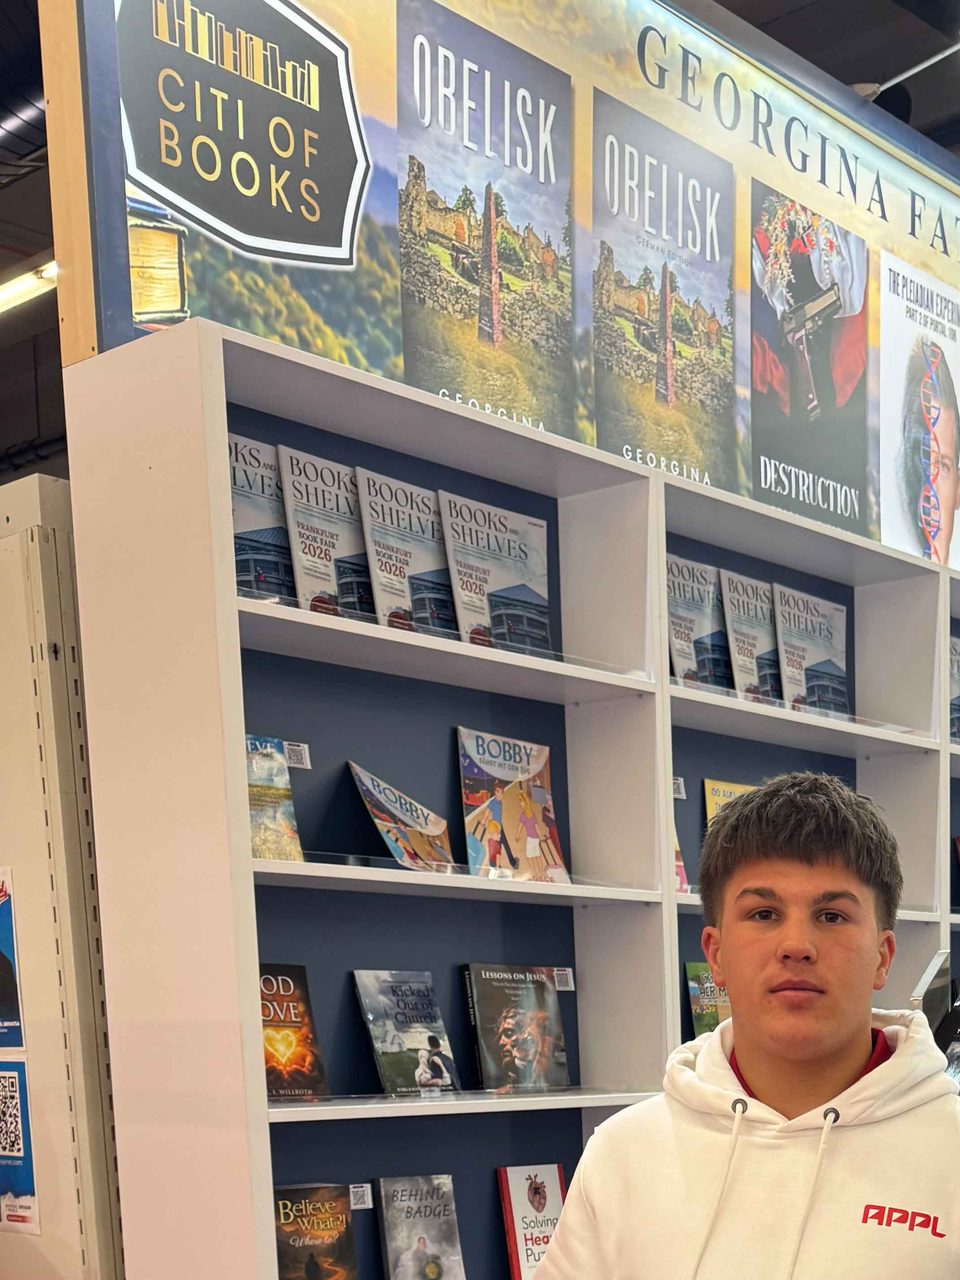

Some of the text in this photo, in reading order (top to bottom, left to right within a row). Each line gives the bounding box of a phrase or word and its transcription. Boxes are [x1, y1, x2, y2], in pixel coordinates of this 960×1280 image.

[157, 68, 320, 168] CITI OF
[412, 33, 559, 186] OBELISK
[637, 25, 889, 222] GEORGINA
[159, 118, 321, 222] BOOKS
[604, 134, 721, 262] OBELISK
[888, 267, 901, 297] THE
[905, 305, 917, 324] PART
[290, 456, 359, 496] BOOKS
[622, 444, 712, 487] GEORGINA
[366, 476, 432, 516] BOOKS
[760, 455, 859, 520] DESTRUCTION
[448, 499, 509, 535] BOOKS
[296, 521, 340, 541] FRANKFURT
[297, 530, 337, 550] BOOK FAIR
[450, 522, 529, 561] SHELVES
[301, 540, 332, 563] 2026
[373, 539, 413, 560] FRANKFURT
[375, 549, 410, 567] BOOK FAIR
[377, 558, 407, 581] 2026
[455, 559, 492, 577] FRANKFURT
[456, 569, 474, 581] BOOK
[459, 578, 486, 597] 2026
[728, 577, 771, 604] BOOKS
[779, 591, 821, 617] BOOKS
[780, 610, 834, 641] SHELVES
[475, 735, 534, 767] BOBBY
[369, 777, 431, 827] BOBBY
[260, 975, 295, 996] OD
[481, 970, 547, 982] LESSONS ON JESUS
[390, 984, 430, 998] Kicked
[261, 1000, 301, 1022] OVE
[397, 997, 433, 1011] Out of
[394, 1010, 437, 1025] Church
[392, 1187, 445, 1202] BEHIND
[278, 1199, 336, 1224] Believe
[405, 1204, 452, 1219] BADGE
[861, 1204, 947, 1239] APPL
